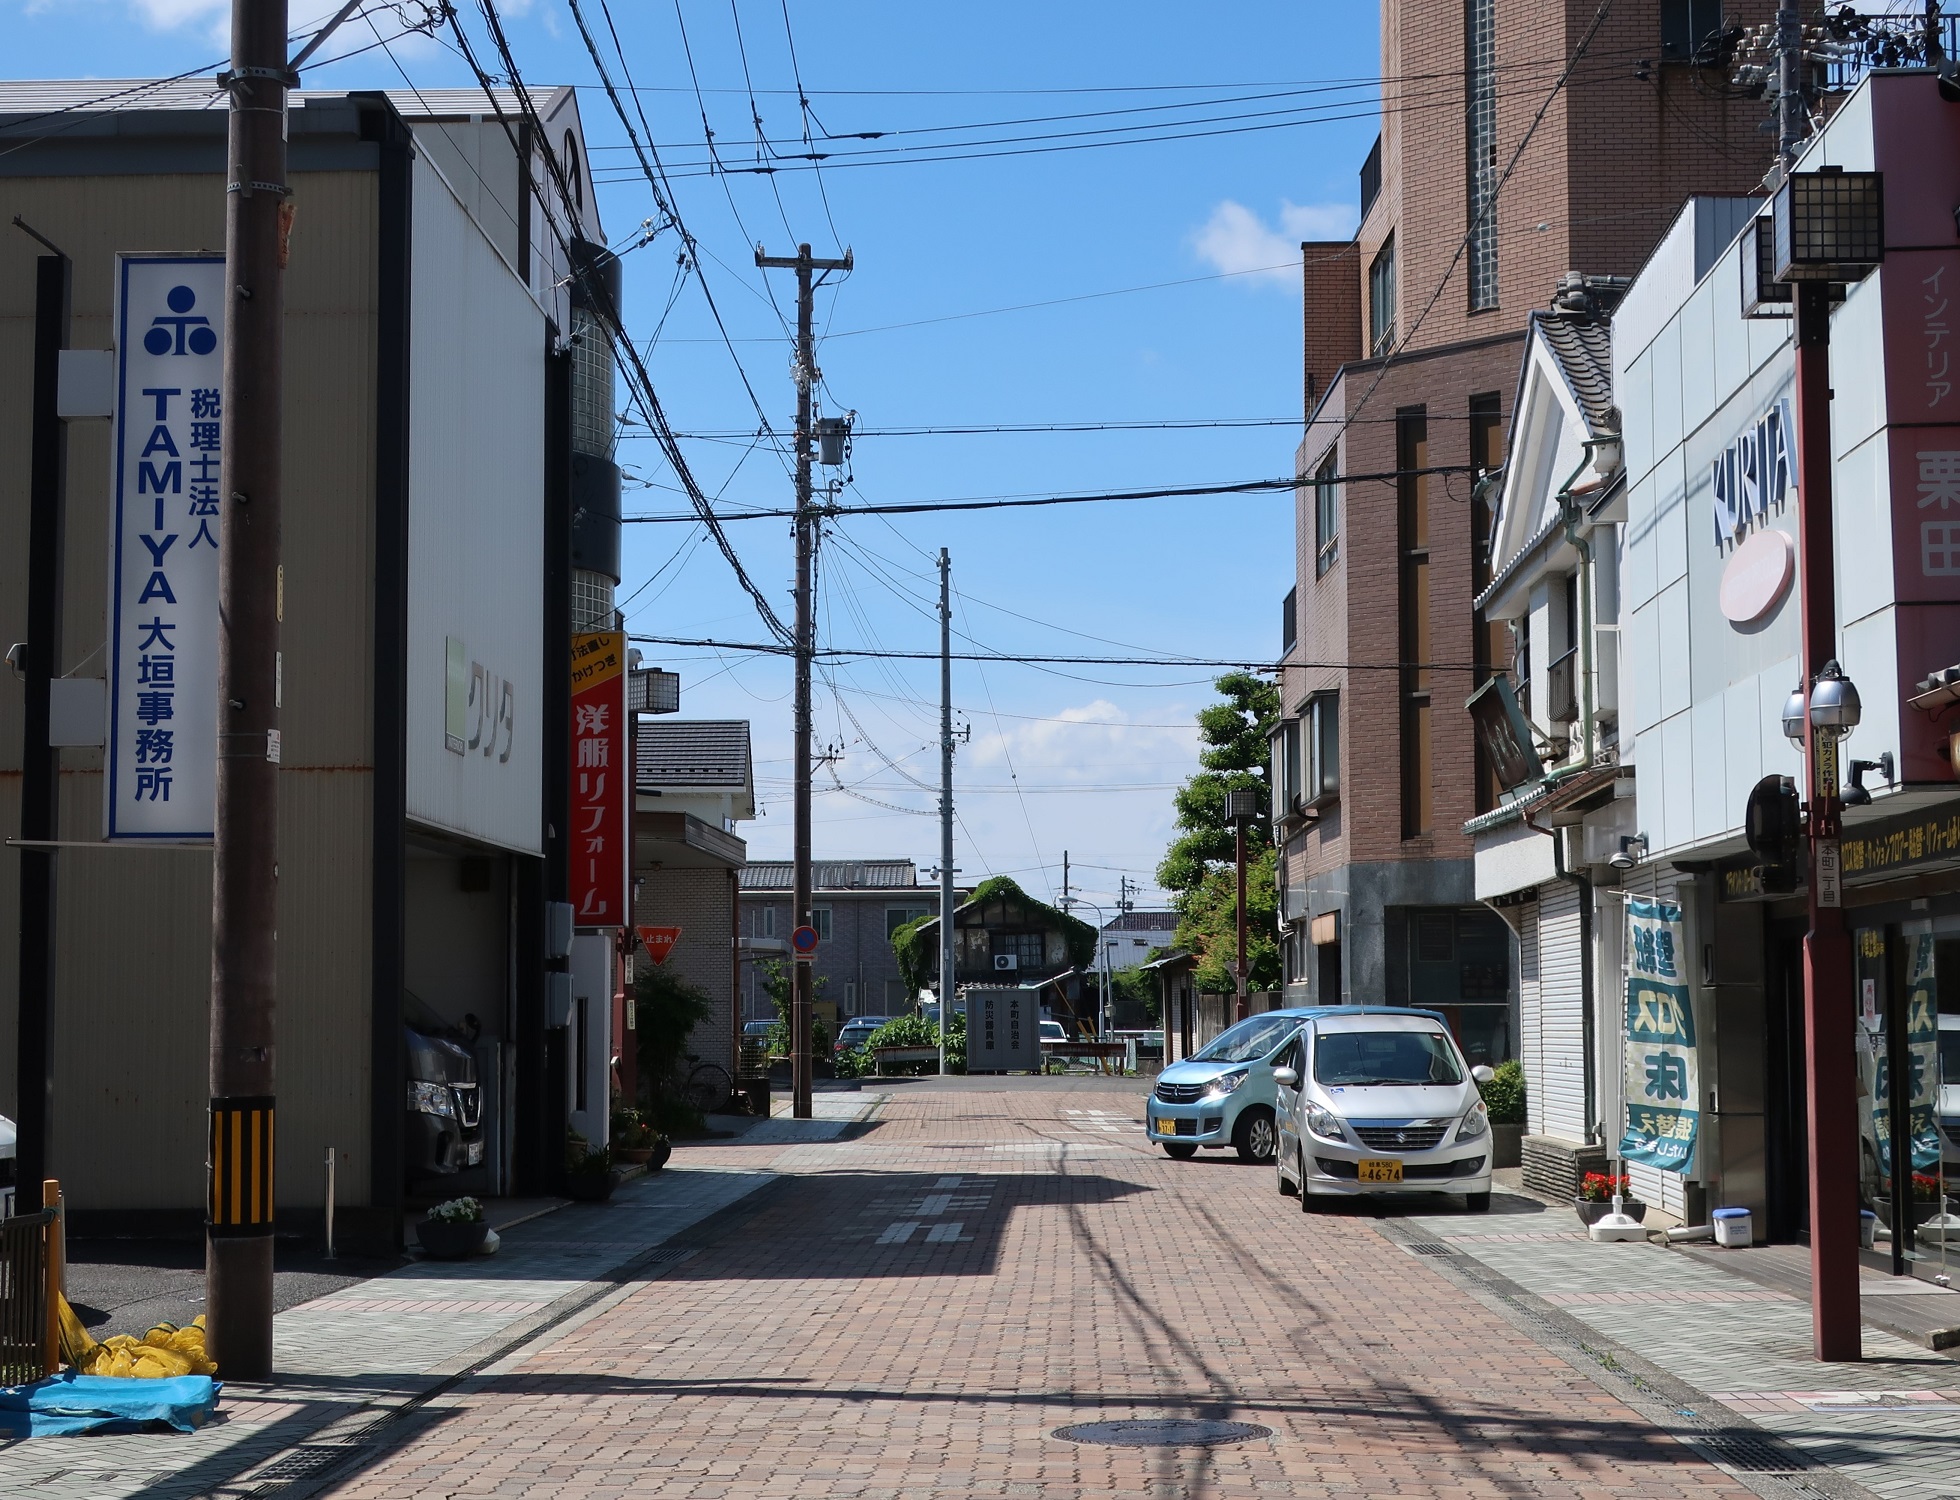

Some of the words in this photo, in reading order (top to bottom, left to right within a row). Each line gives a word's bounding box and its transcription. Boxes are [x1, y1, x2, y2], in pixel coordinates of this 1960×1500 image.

[1922, 266, 1951, 408] インテリア
[138, 388, 182, 604] TAMIYA
[188, 388, 221, 549] 税理士法人
[1711, 398, 1798, 546] KURITA
[134, 617, 176, 802] 大垣事務所
[468, 661, 514, 763] クリタ
[572, 654, 617, 682] かけつぎ
[576, 704, 609, 916] 洋服リフォーム
[1821, 844, 1835, 902] 本町二丁目
[646, 934, 673, 944] 止まれ
[984, 1000, 995, 1050] 防災器具庫
[1010, 1000, 1020, 1050] 本町自治会
[1368, 1169, 1400, 1180] 46-74
